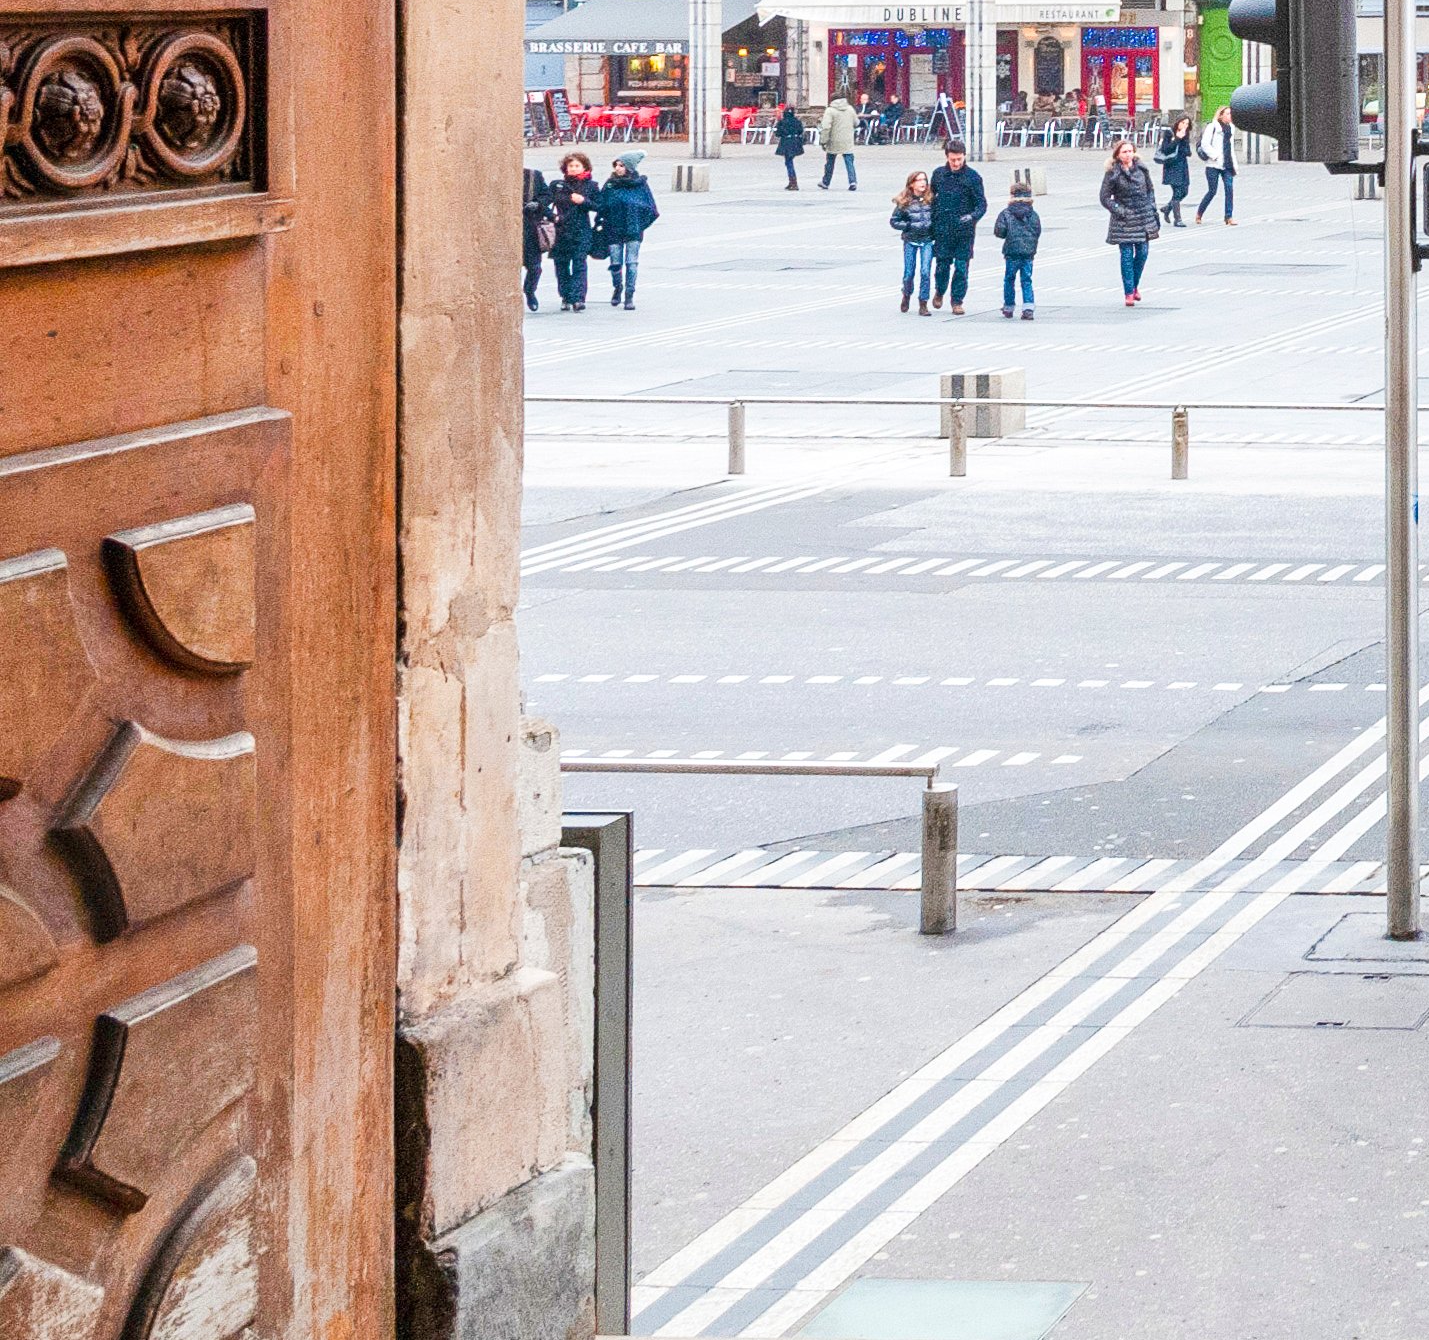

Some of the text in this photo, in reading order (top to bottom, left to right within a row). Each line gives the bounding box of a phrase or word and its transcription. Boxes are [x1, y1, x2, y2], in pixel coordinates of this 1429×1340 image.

[883, 7, 1099, 22] DUBLINE RESTAURANT
[529, 41, 683, 54] BRASSERIE CAFE BAR
